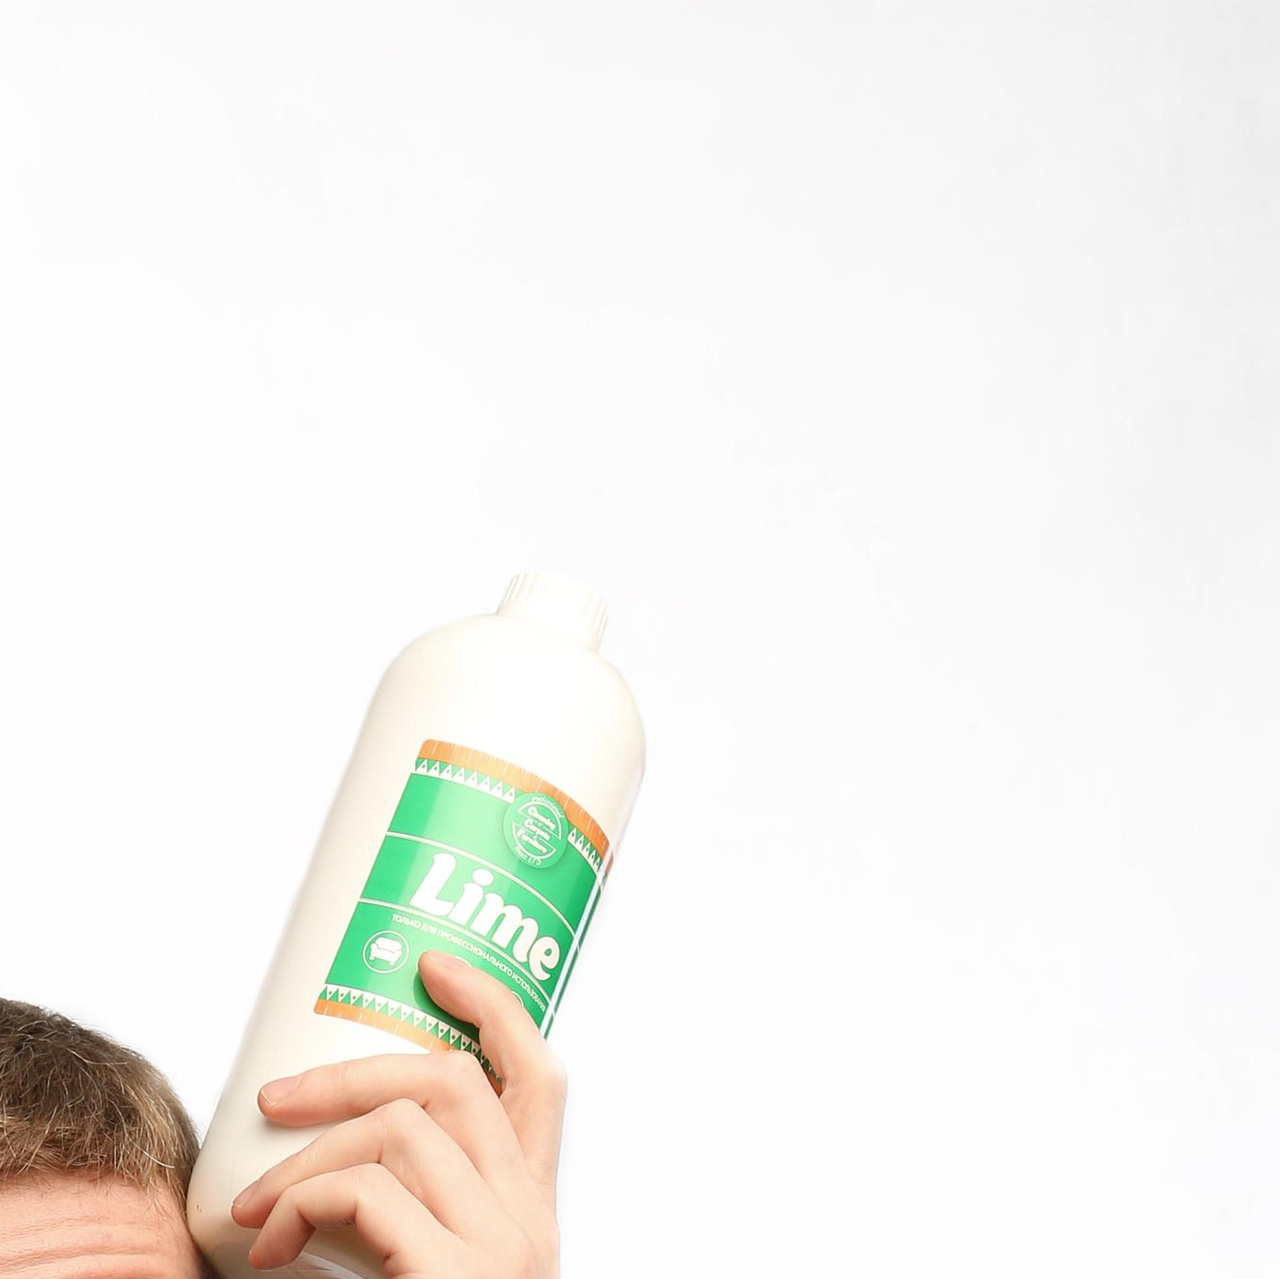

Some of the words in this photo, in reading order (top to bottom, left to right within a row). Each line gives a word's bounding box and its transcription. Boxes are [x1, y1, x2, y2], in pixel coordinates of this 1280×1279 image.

[391, 913, 420, 928] ТОЛЬКО
[420, 925, 437, 934] ДЛЯ
[408, 853, 561, 982] Lime
